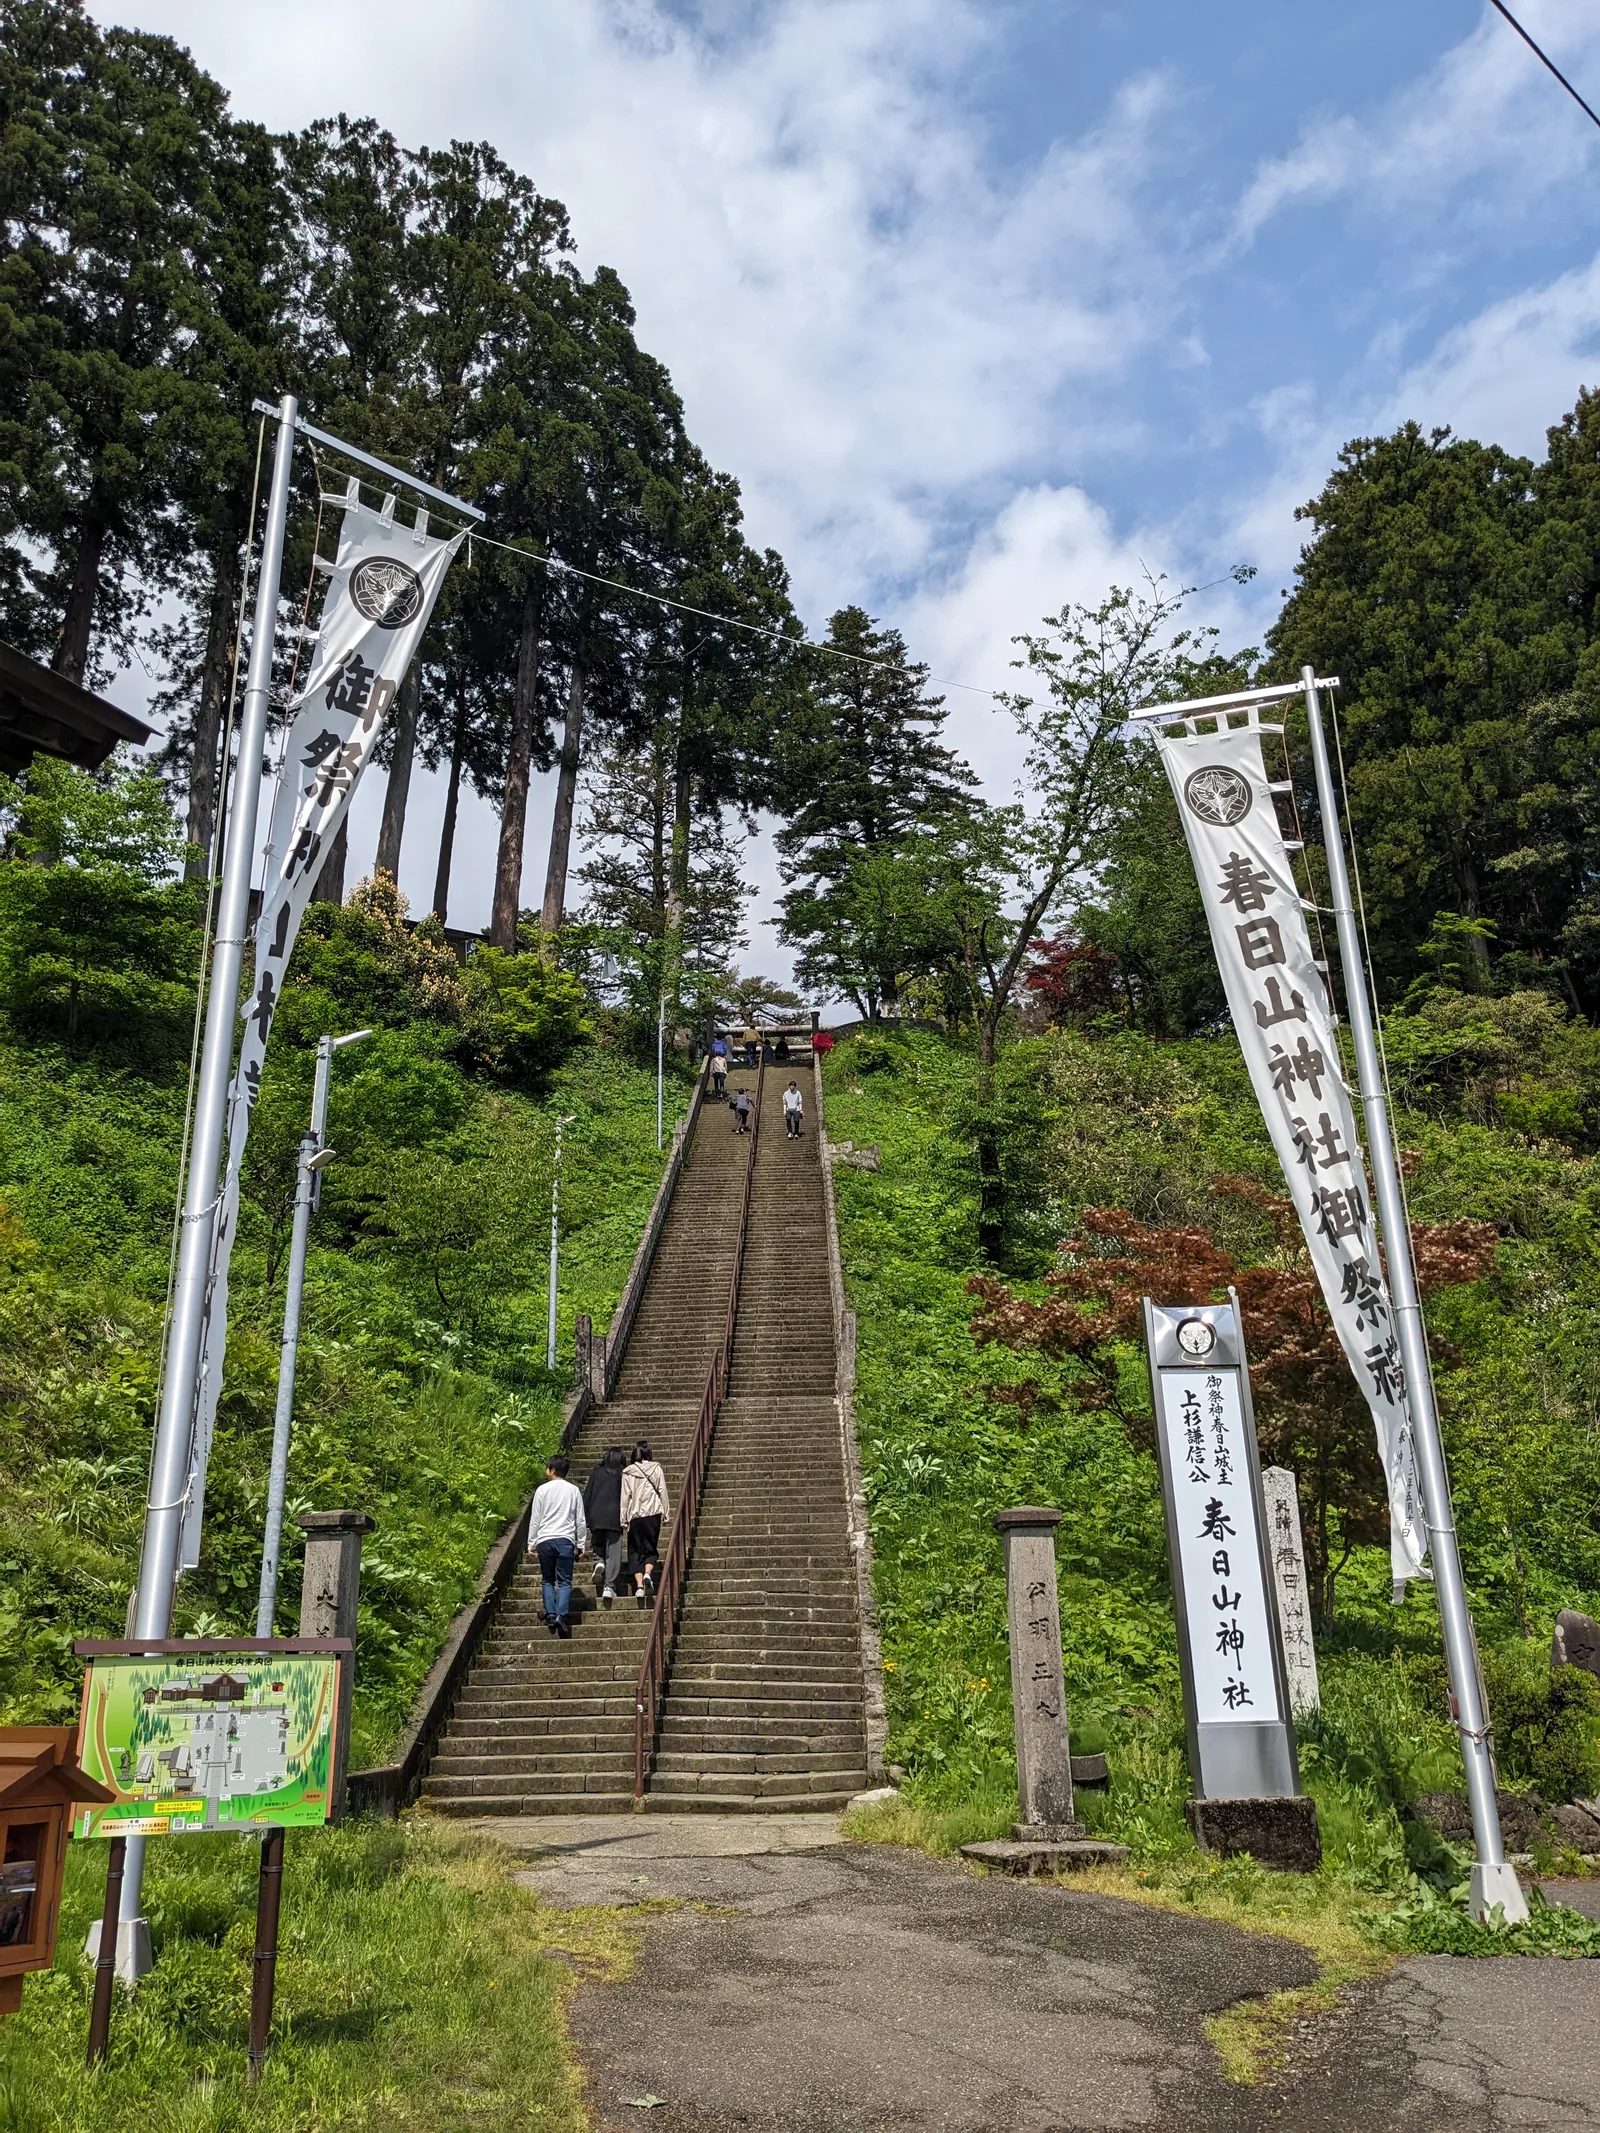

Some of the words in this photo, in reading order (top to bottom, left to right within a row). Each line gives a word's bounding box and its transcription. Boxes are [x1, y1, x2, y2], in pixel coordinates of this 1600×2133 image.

[1180, 1389, 1211, 1483] 上杉謙信公
[1205, 1375, 1234, 1485] 御祭神春日山城主
[1195, 1497, 1254, 1710] 春日山神社
[175, 1656, 273, 1668] 春日山神社境内案内図
